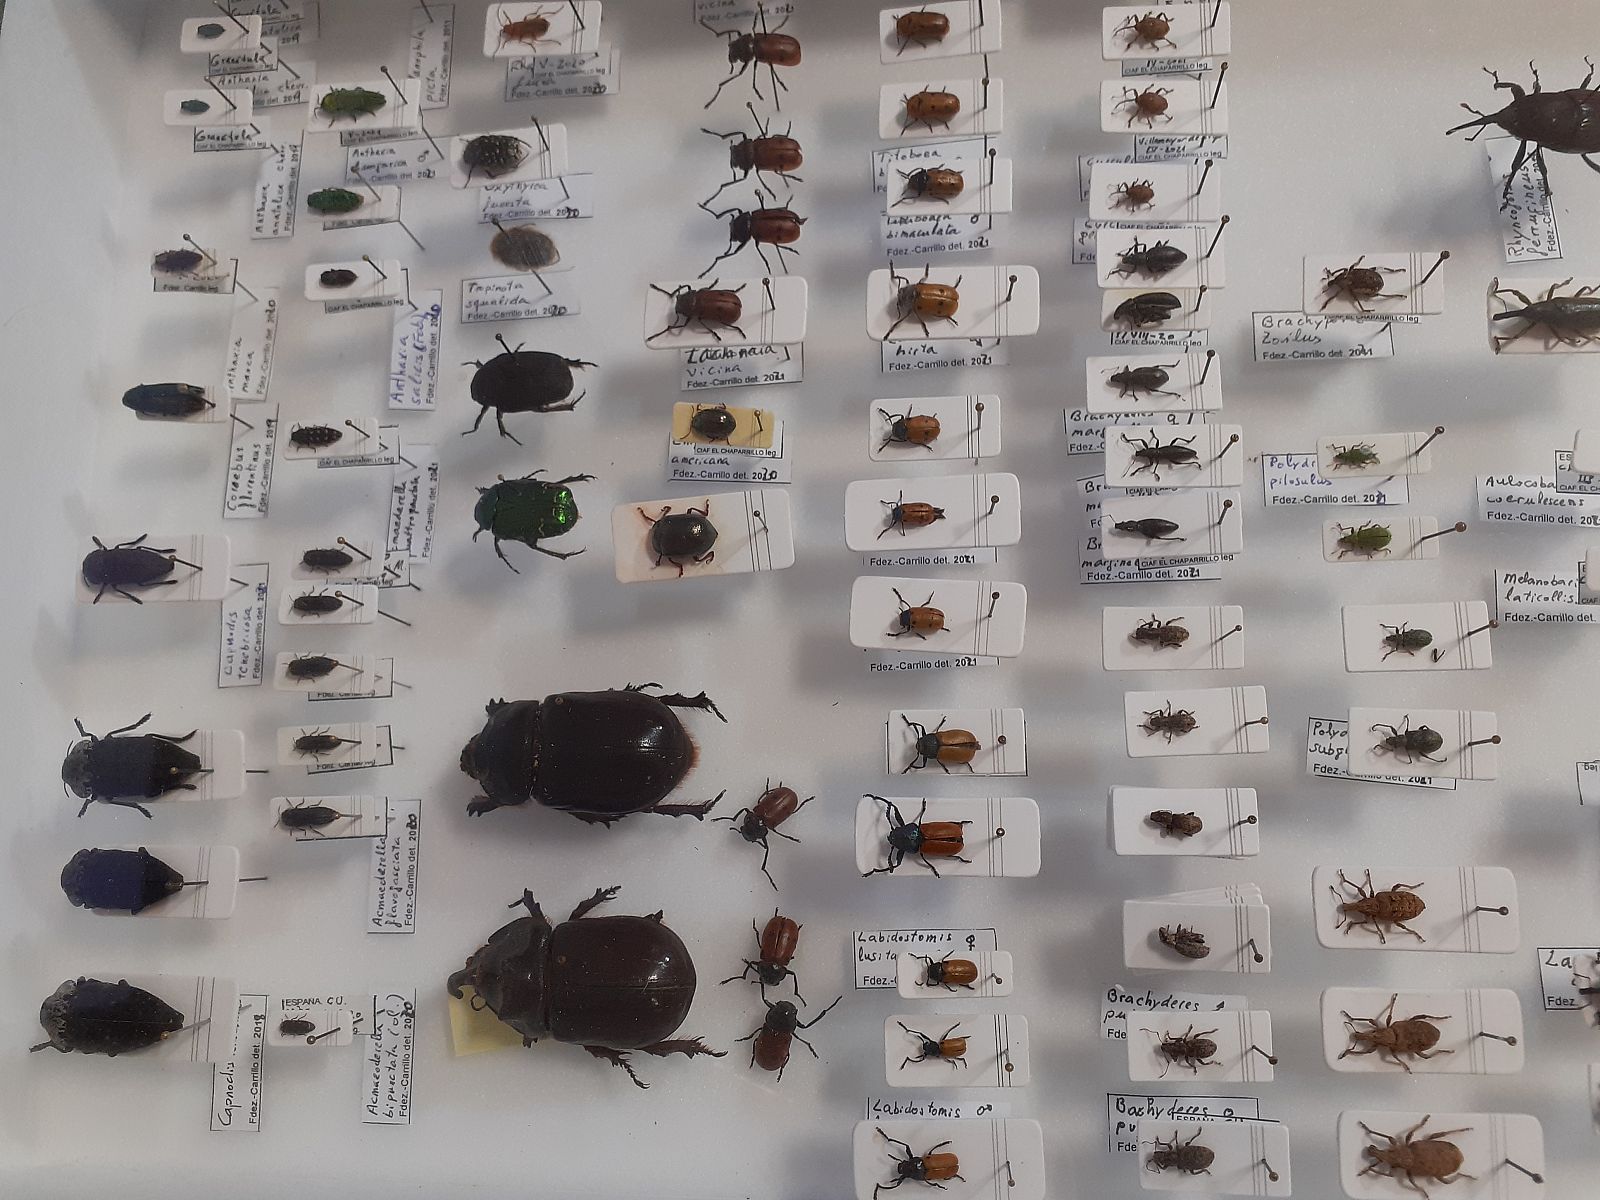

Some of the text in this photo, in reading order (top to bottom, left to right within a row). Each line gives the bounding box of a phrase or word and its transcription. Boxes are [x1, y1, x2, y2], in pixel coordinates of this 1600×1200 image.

[889, 361, 948, 371] Fdez.-Carrillo
[721, 448, 763, 456] CHAPARRILLO
[673, 469, 730, 479] Fdez.-Carrillo
[1272, 495, 1338, 504] Fdez.-Carrillo
[1487, 511, 1555, 523] Fdez.-Carrillo
[870, 557, 930, 566] Fdez.-Carrillo
[934, 556, 950, 564] det.
[1169, 555, 1219, 565] CHAPARRILLO
[1087, 571, 1153, 581] Fdez.-Carrillo
[1503, 572, 1577, 588] Melanobari
[1504, 612, 1575, 622] Fdez.-Carrillo
[870, 661, 932, 671] Fdez.-Carrillo
[935, 659, 952, 668] det.
[408, 845, 416, 861] det.
[405, 865, 415, 926] Fdez.-Carrillo
[858, 949, 896, 962] lusita
[404, 1033, 412, 1050] det.
[250, 1041, 261, 1059] det.
[399, 1053, 410, 1117] Fdez.-Carrillo
[248, 1062, 261, 1124] Fdez.-Carrillo
